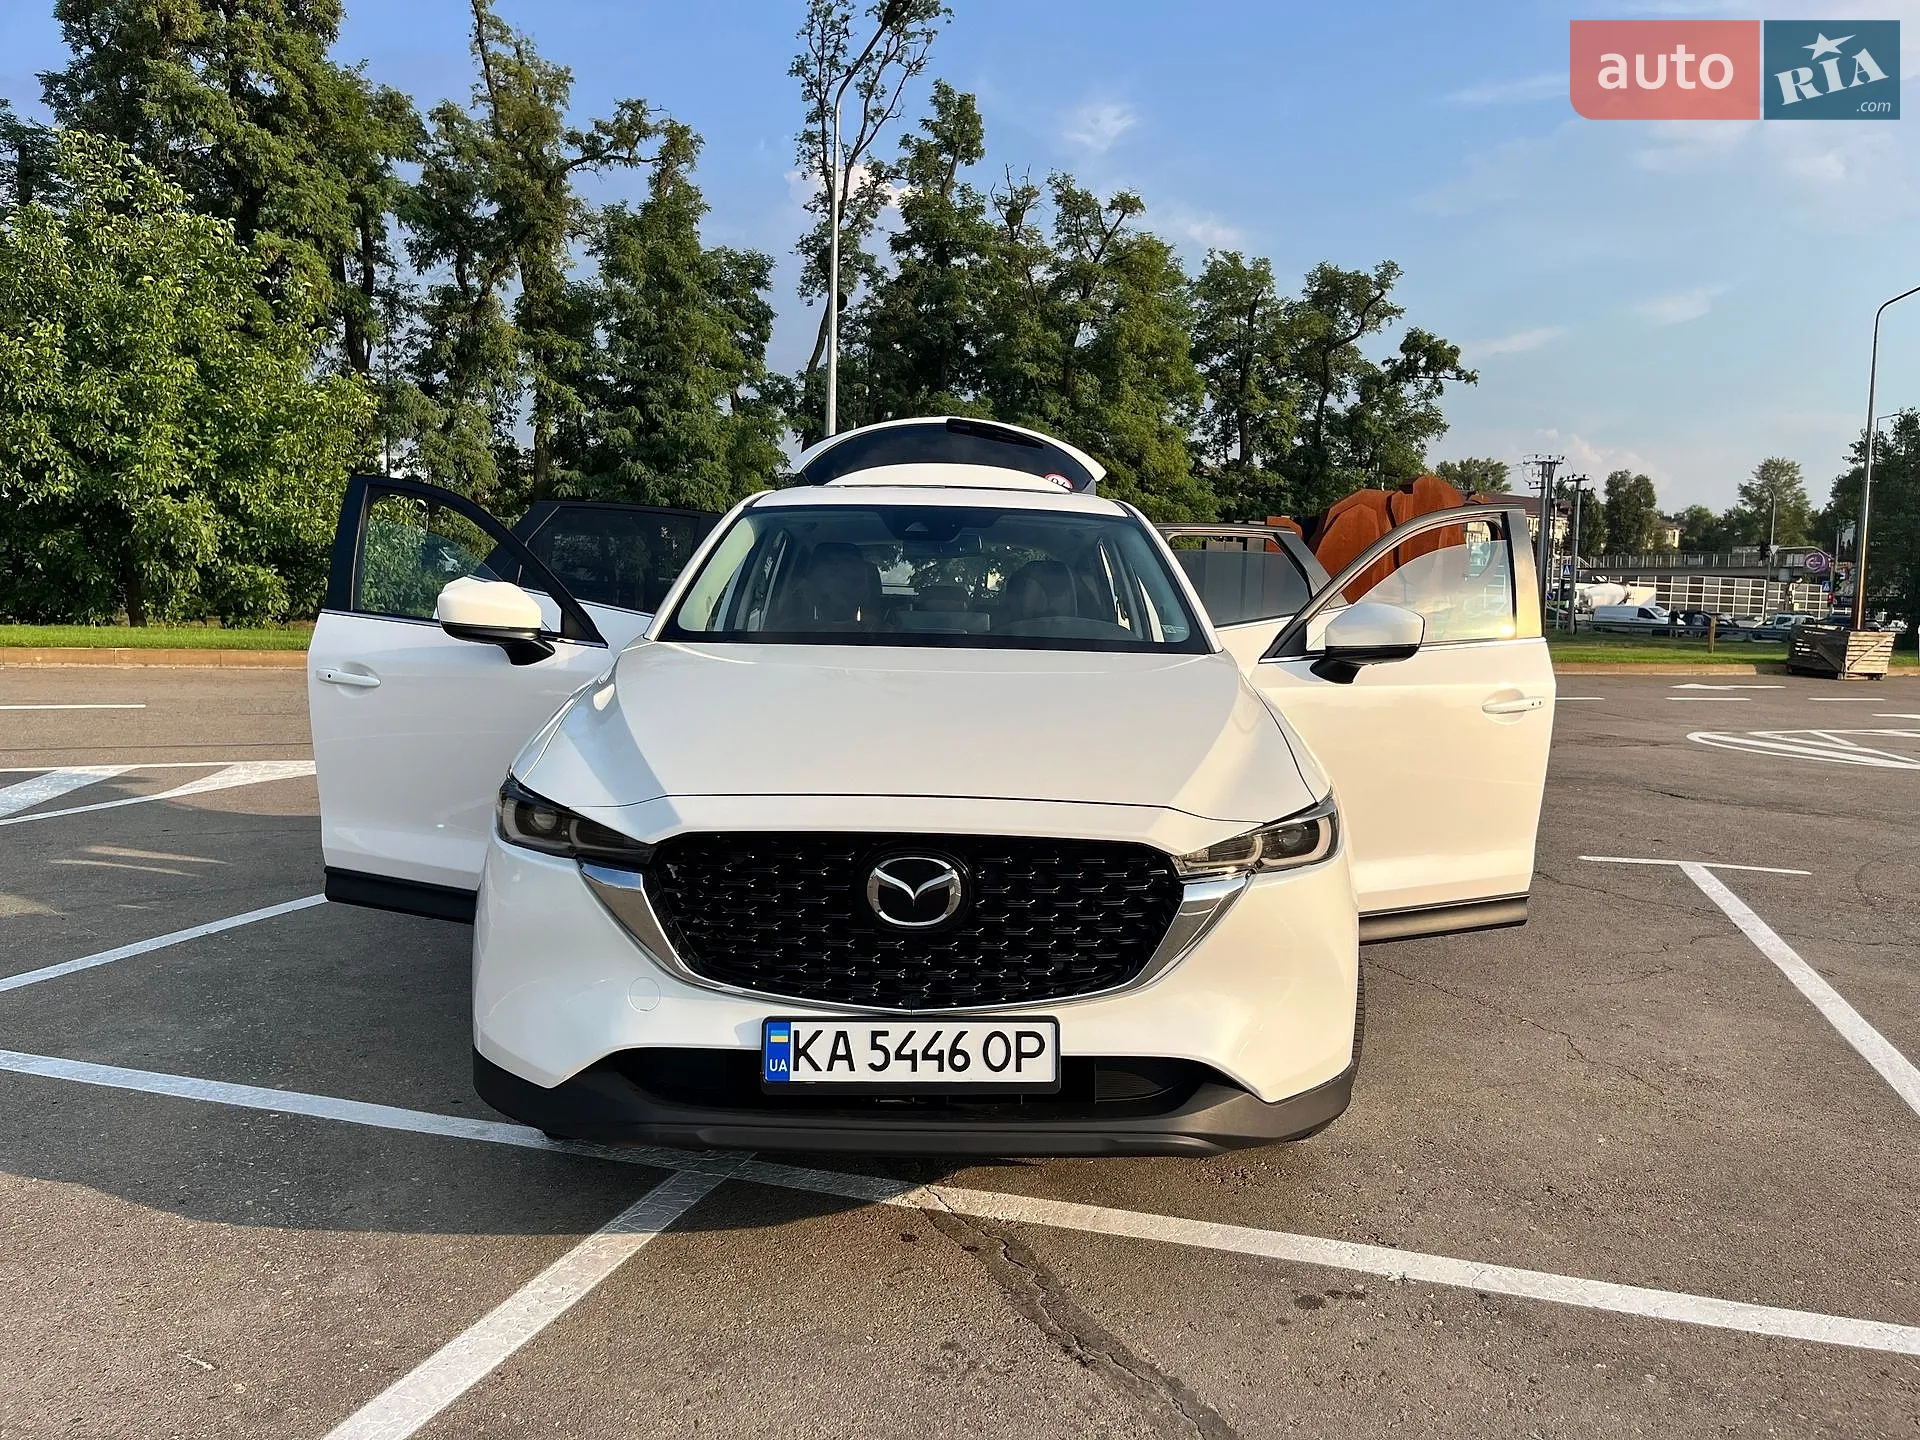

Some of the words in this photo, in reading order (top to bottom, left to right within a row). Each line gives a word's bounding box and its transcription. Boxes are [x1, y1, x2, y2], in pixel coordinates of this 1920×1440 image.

[769, 1059, 788, 1072] UA
[793, 1030, 856, 1072] KA
[867, 1030, 971, 1073] 5446
[982, 1030, 1046, 1073] OP
